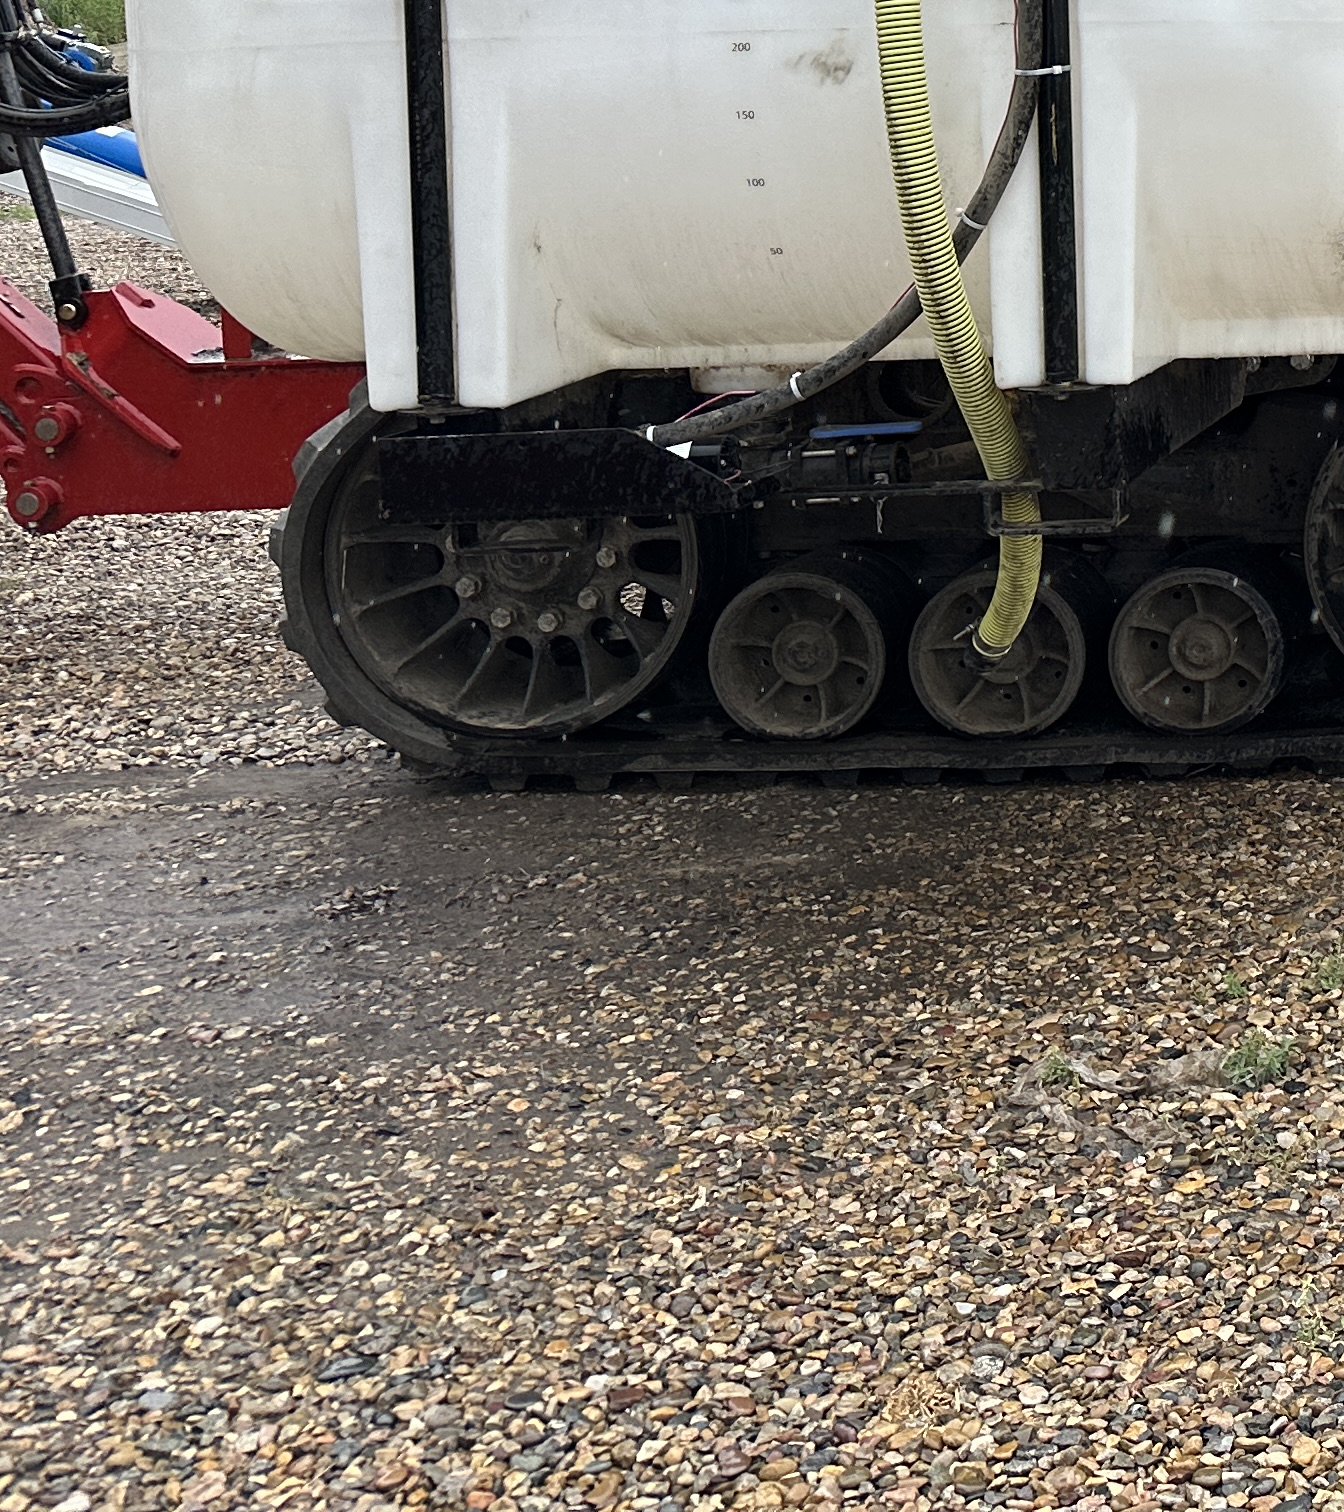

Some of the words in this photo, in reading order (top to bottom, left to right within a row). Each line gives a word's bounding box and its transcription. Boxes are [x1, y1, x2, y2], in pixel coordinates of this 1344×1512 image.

[731, 42, 751, 53] 200
[735, 110, 755, 120] 150
[746, 177, 766, 187] 100
[769, 247, 784, 256] 50
